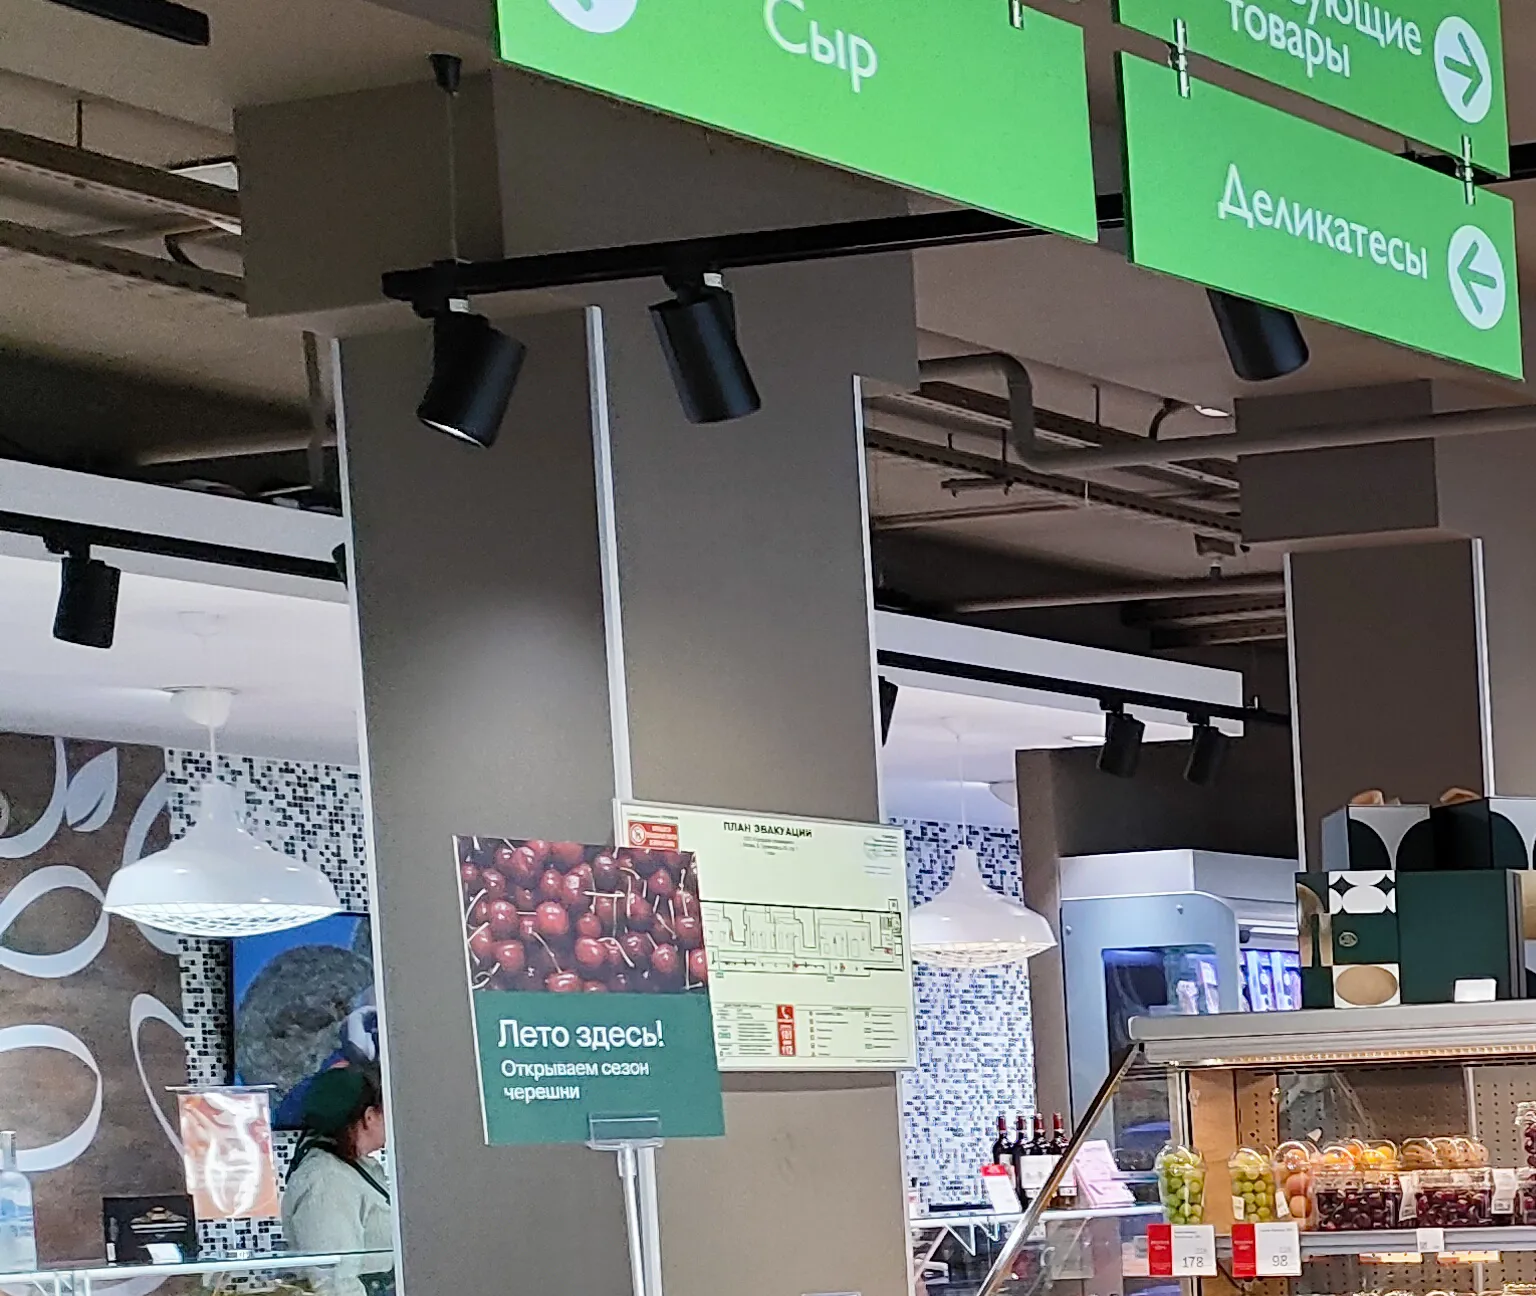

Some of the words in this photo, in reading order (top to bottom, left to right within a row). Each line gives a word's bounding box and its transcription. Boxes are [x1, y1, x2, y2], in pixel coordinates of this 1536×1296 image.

[1226, 0, 1350, 78] товары
[1291, 0, 1422, 55] ующие
[762, 0, 878, 93] Сыр
[1217, 162, 1428, 279] Деликатесы
[723, 821, 752, 834] ПЛАН
[754, 824, 813, 838] ЭВАКУАЦИИ
[498, 1019, 570, 1048] Лето
[575, 1019, 665, 1051] здесь!
[501, 1059, 599, 1081] Открываем
[601, 1062, 650, 1076] сезон
[503, 1085, 580, 1104] черешни
[1181, 1256, 1204, 1268] 178
[1271, 1255, 1289, 1267] 98
